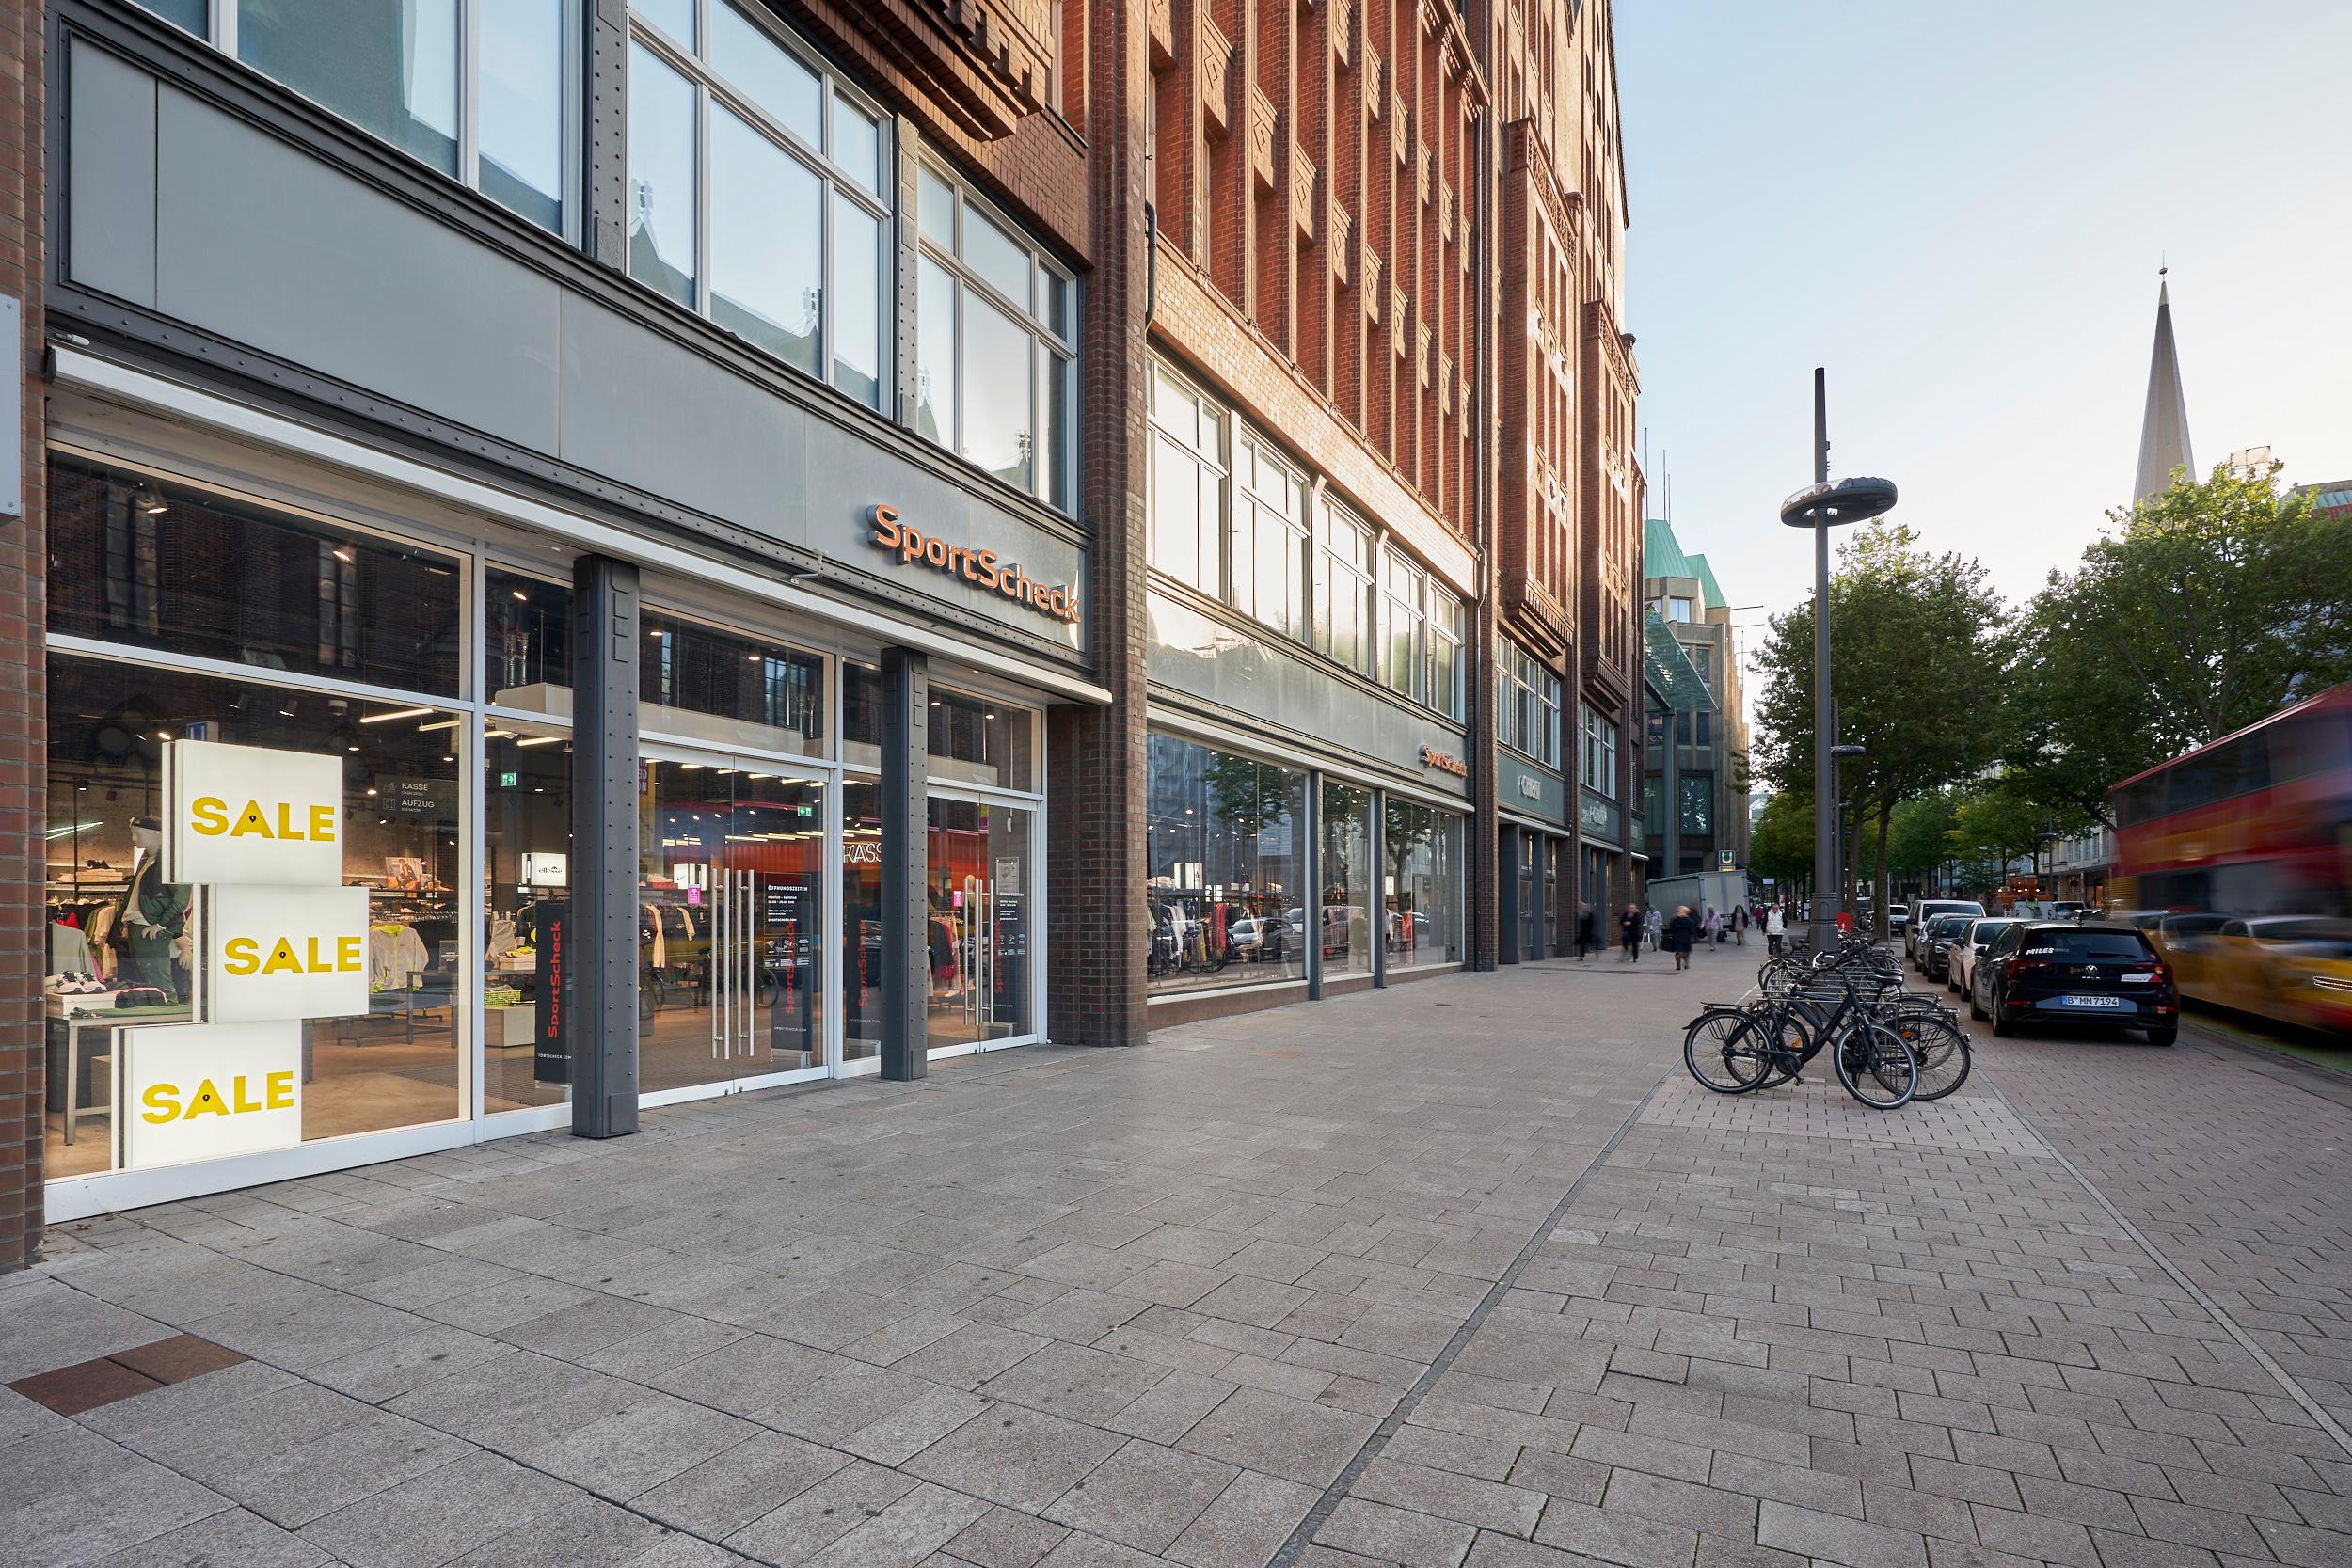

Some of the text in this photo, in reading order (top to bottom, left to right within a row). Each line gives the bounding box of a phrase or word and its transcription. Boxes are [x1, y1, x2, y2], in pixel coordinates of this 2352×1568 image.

[868, 503, 1081, 623] SportScheck
[401, 783, 429, 791] KASSE
[401, 800, 435, 808] AUFZUG
[191, 796, 335, 843] SALE
[224, 937, 362, 975] SALE
[2026, 947, 2055, 956] MILES
[548, 919, 562, 1038] SportScheck
[2067, 996, 2074, 1005] B
[141, 1070, 294, 1124] SALE
